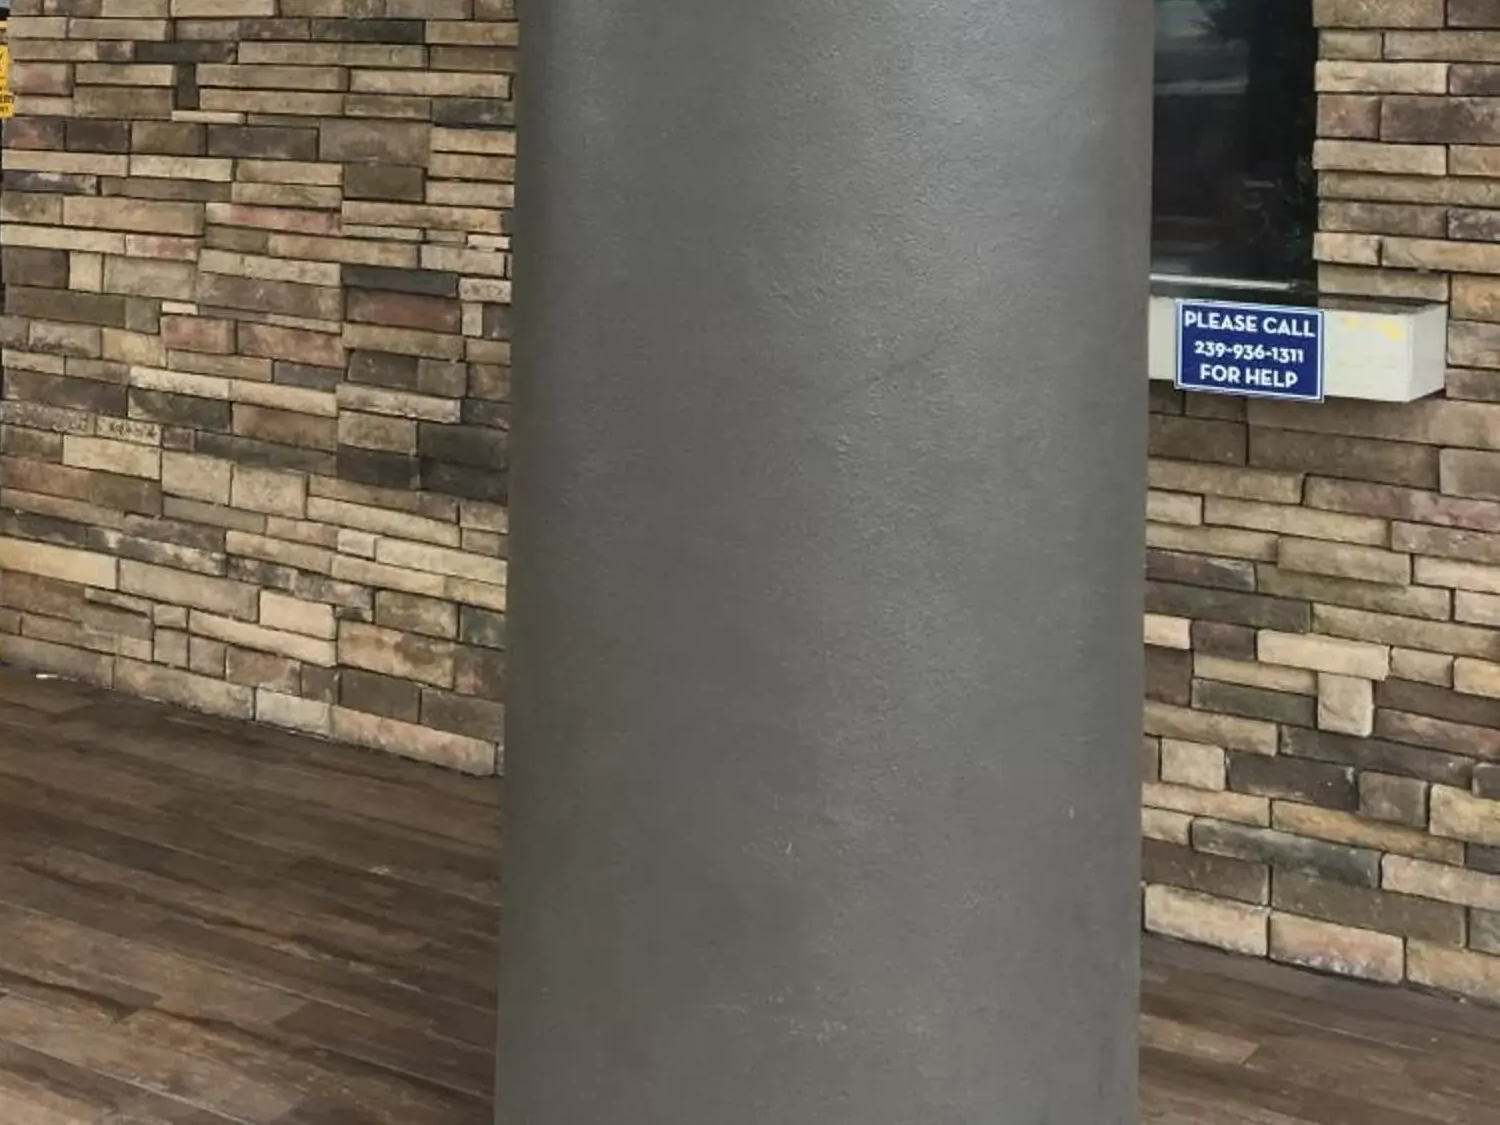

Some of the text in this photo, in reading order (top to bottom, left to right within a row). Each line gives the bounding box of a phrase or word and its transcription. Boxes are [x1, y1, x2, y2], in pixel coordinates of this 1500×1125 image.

[1184, 310, 1316, 338] PLEASE CALL
[1193, 340, 1305, 364] 239-936-1311
[1200, 363, 1299, 388] FOR HELP
